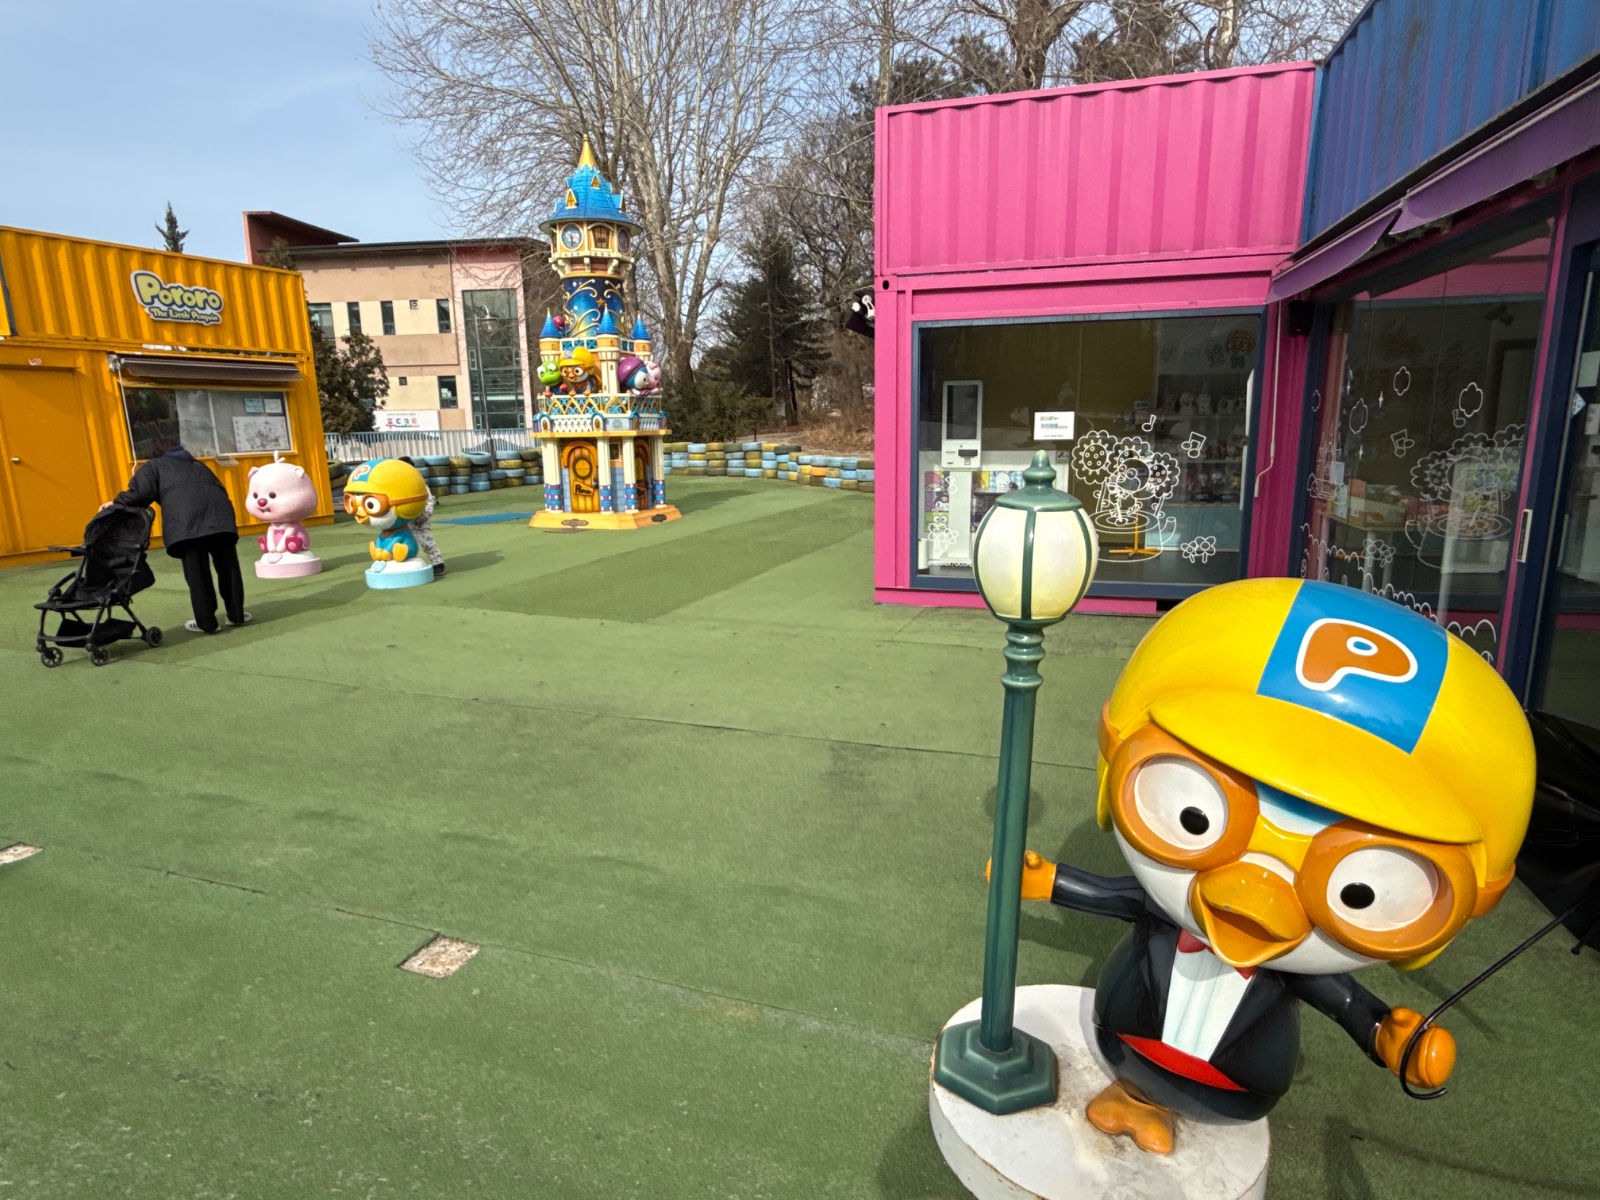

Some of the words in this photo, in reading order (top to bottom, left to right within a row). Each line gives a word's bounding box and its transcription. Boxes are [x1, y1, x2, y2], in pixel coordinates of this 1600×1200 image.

[134, 273, 221, 310] Pororo
[149, 307, 169, 319] The
[168, 308, 191, 320] Little
[190, 310, 219, 323] Penguin
[1295, 617, 1418, 691] P
